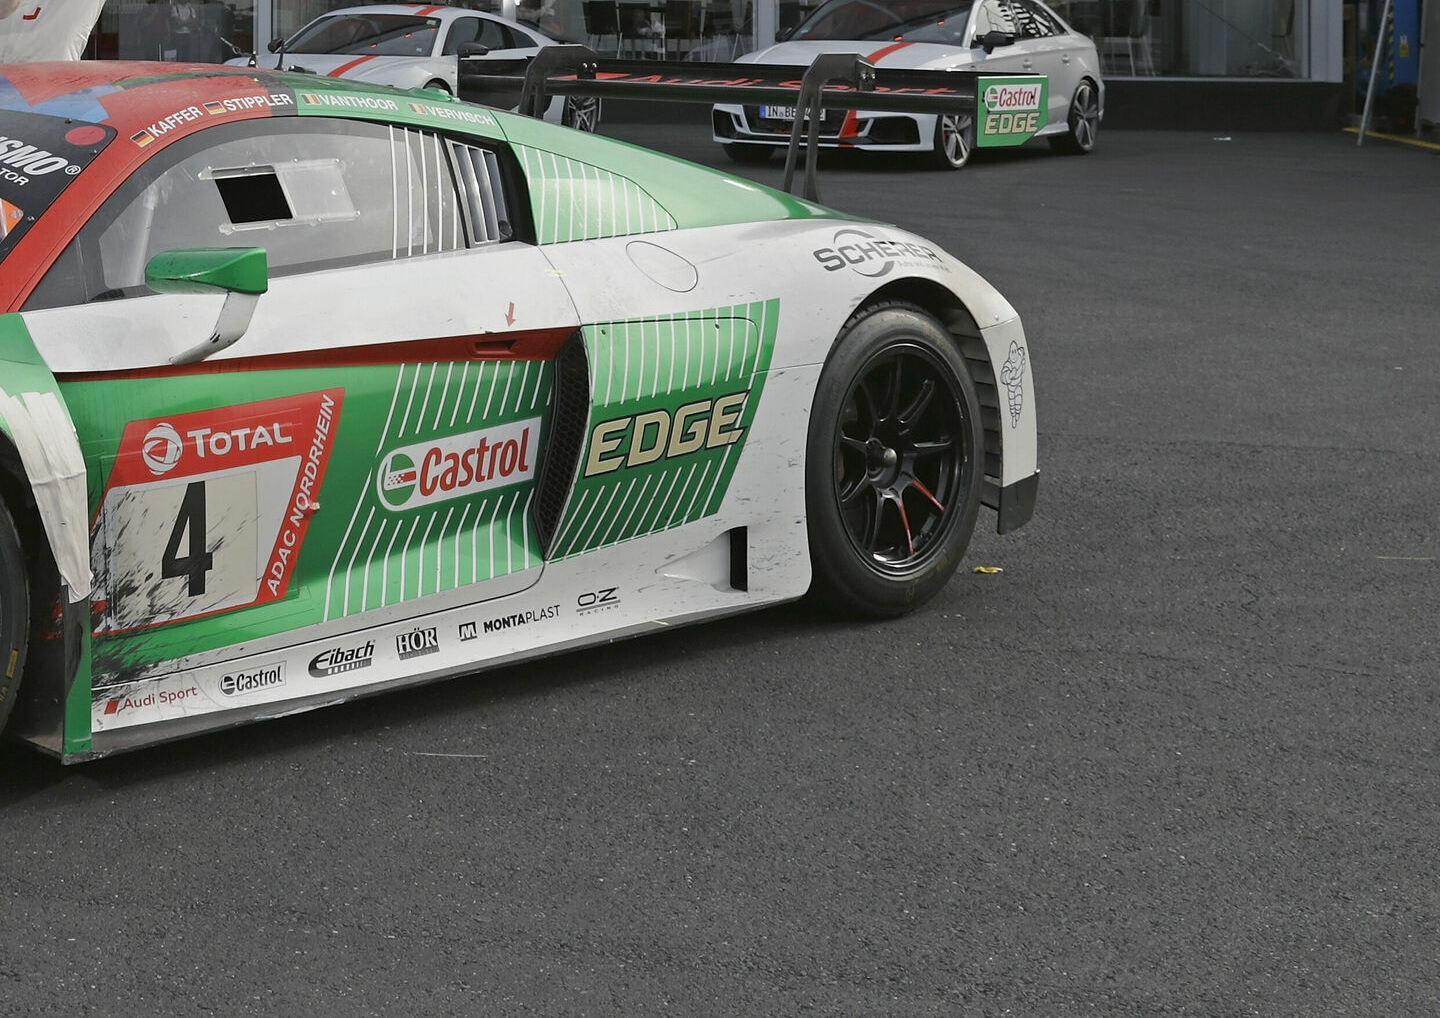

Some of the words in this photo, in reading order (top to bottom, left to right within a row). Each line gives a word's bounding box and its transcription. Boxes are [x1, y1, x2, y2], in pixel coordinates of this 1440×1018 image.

[998, 87, 1038, 108] Castrol
[148, 106, 204, 138] KAFFER
[222, 92, 294, 114] STIPPLER
[318, 94, 399, 112] VANTHOOR
[426, 105, 496, 127] VERVISCH
[984, 112, 1041, 135] EDGE
[813, 240, 944, 272] SCHERER
[187, 422, 293, 458] TOTAL
[584, 390, 752, 478] EDGE
[420, 427, 530, 497] Castrol
[264, 529, 297, 597] ADAC
[289, 393, 336, 528] NORDRHEIN
[162, 480, 213, 597] 4
[484, 604, 561, 633] MONTAPLAST
[396, 627, 438, 656] HÖR
[309, 641, 375, 676] Eibach
[236, 666, 283, 692] Castrol
[122, 693, 156, 710] Audi
[160, 686, 198, 705] Sport
